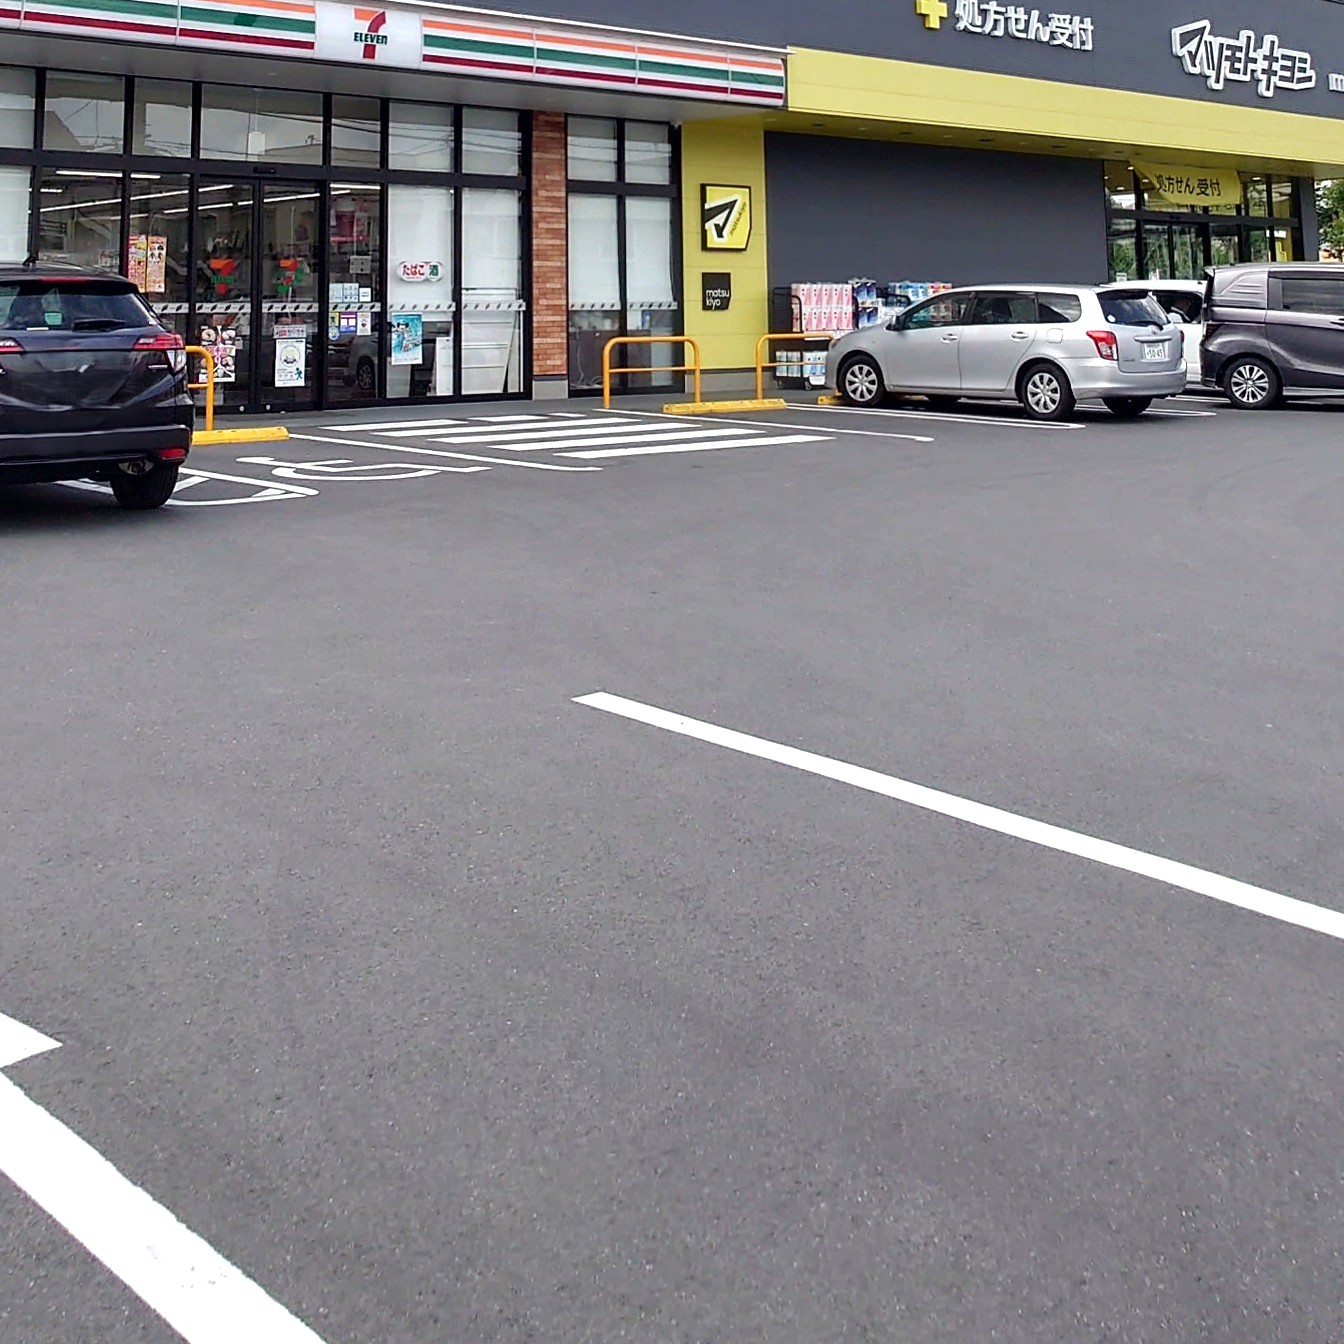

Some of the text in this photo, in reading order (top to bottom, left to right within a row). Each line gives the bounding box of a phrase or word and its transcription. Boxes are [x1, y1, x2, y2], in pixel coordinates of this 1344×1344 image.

[402, 263, 425, 276] たばこ
[706, 289, 730, 298] matsu
[706, 298, 721, 310] kiyo
